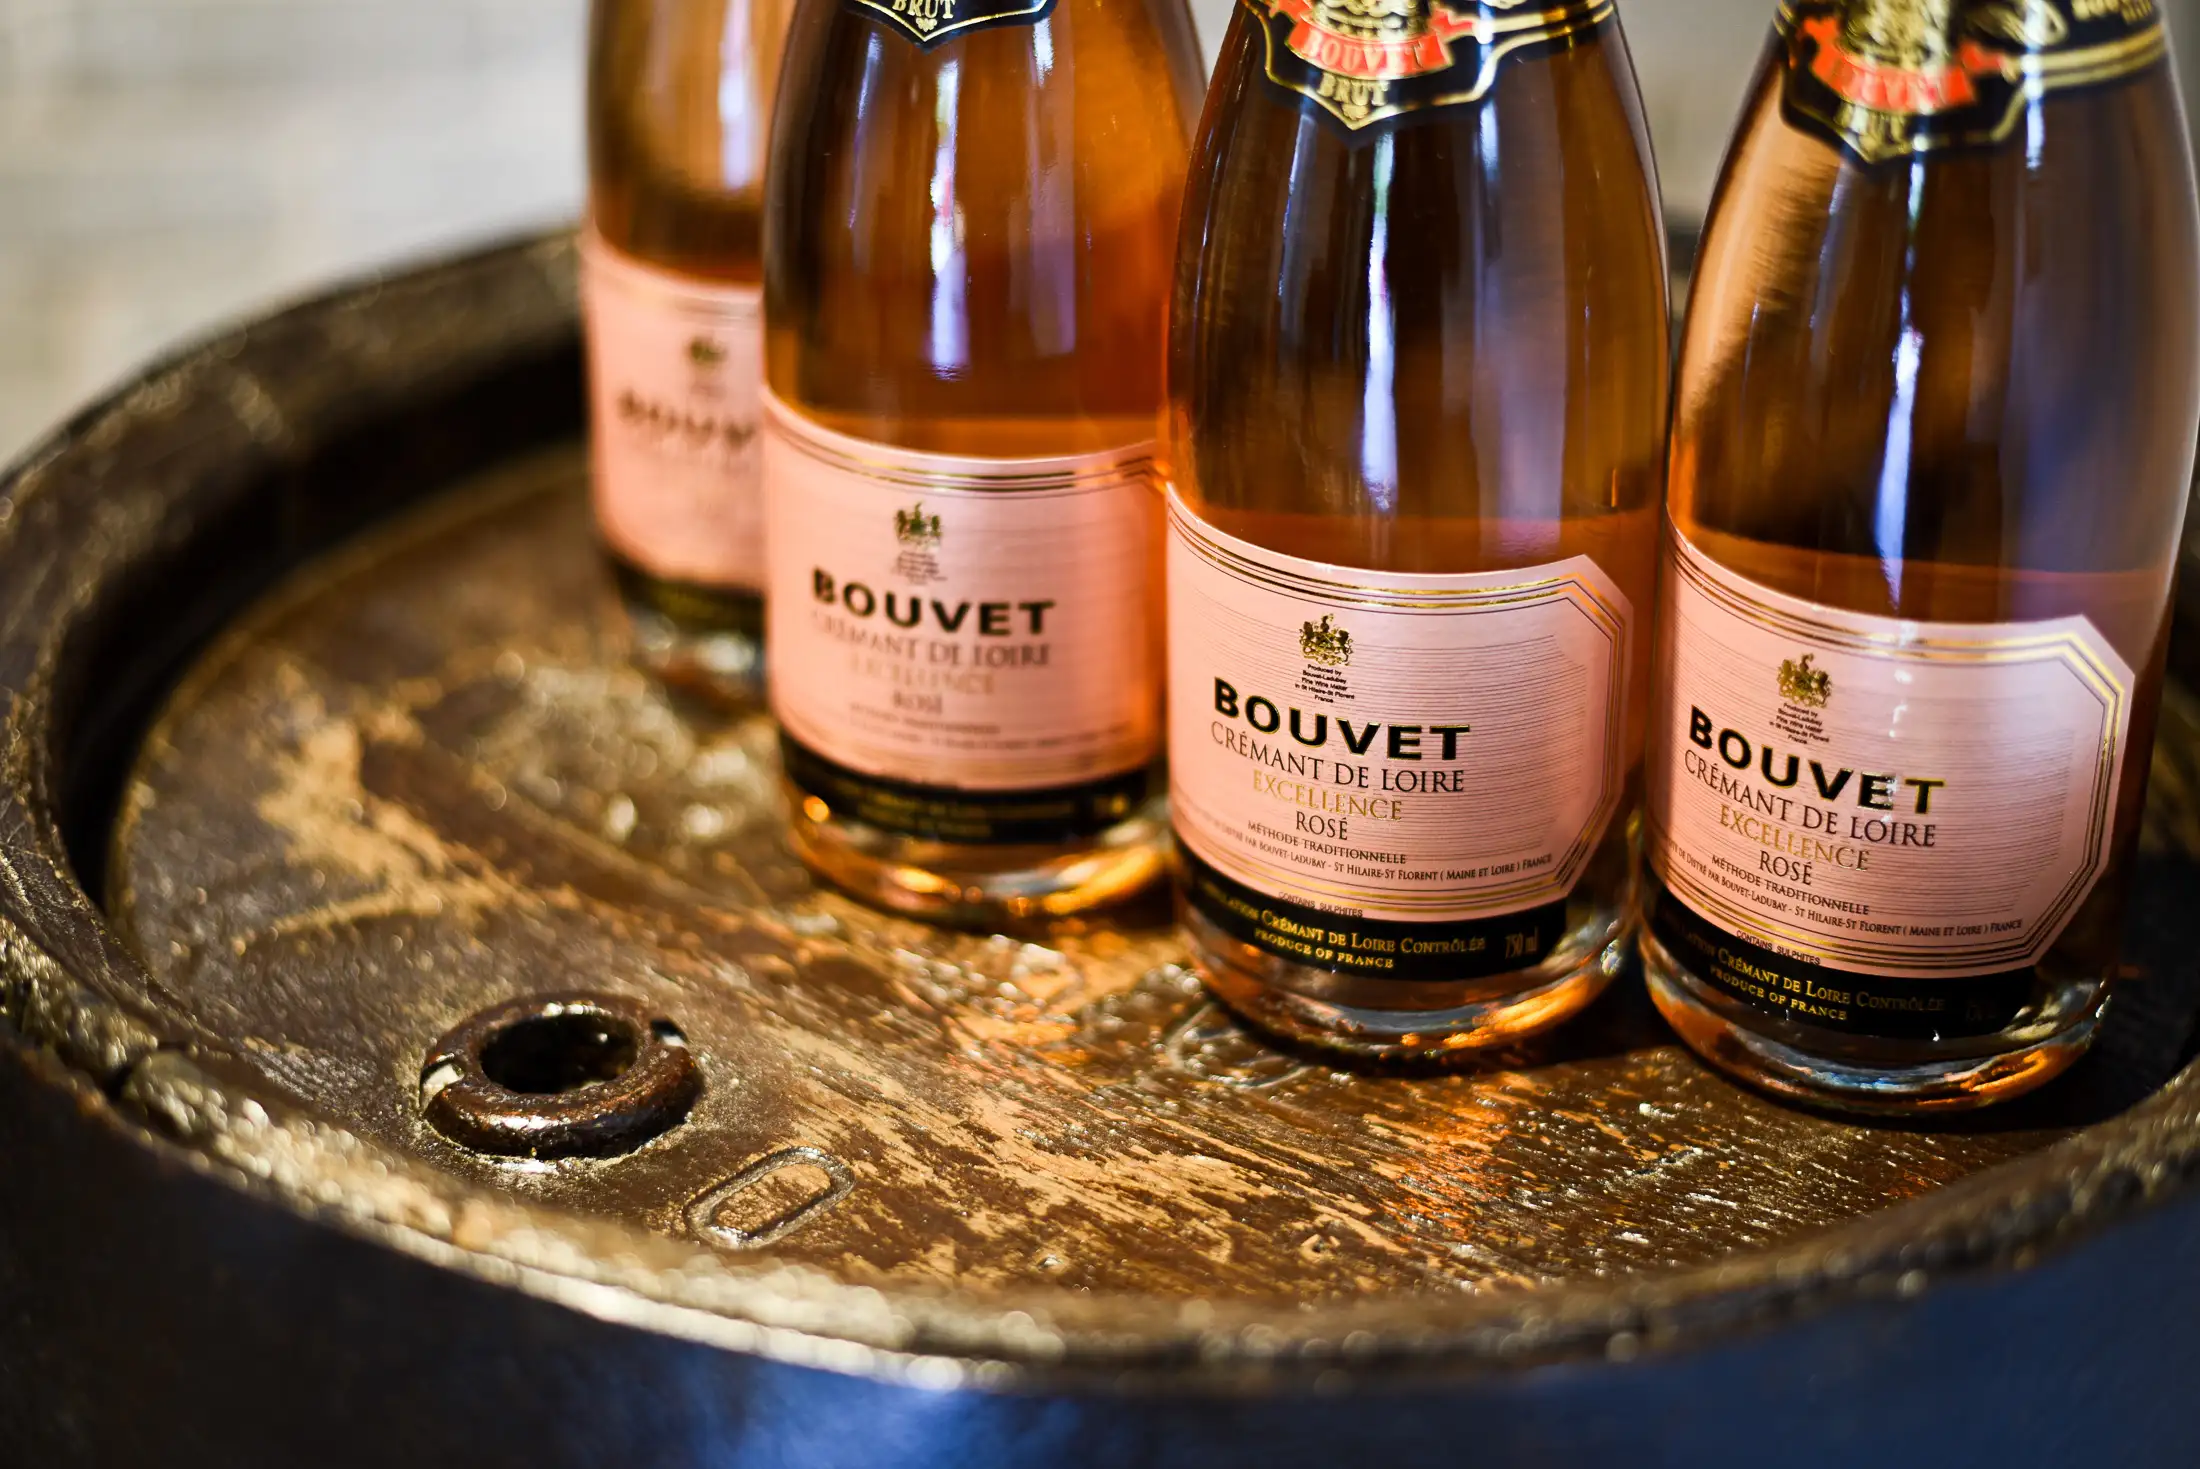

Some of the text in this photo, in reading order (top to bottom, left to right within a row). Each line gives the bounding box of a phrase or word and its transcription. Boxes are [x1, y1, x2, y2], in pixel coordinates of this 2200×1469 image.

[1317, 71, 1391, 106] BRUT
[812, 565, 1057, 636] BOUVET
[1213, 676, 1471, 761] BOUVET
[1210, 720, 1465, 793] CRÉMANT DE LOIRE
[1689, 703, 1946, 815] BOUVET
[1253, 769, 1403, 821] EXCELLENCE
[1685, 748, 1937, 848] CRÉMANT DE LOIRE
[1247, 819, 1407, 865] MÉTHODE TRADITIONNELLE
[1296, 810, 1349, 841] ROSÉ
[1720, 803, 1870, 872] EXCELLENCE
[1334, 861, 1345, 873] ST
[1398, 870, 1438, 881] FLORENT
[1446, 869, 1476, 880] MAINE
[1478, 868, 1489, 877] ET
[1491, 863, 1515, 876] LOIRE
[1711, 854, 1870, 916] MÉTHODE TRADITIONNELLE
[1759, 849, 1813, 886] ROSÉ
[1278, 891, 1316, 909] CONTAINS
[1319, 902, 1363, 917] SULPHITES
[1794, 905, 1806, 918] ST
[1860, 920, 1902, 936] FLORENT
[1909, 926, 1941, 937] MAINE
[1943, 926, 1955, 937] ET
[1956, 925, 1982, 936] LOIRE
[1990, 918, 2023, 933] FRANCE
[1254, 927, 1393, 969] PRODUCE OF FRANCE
[1328, 931, 1347, 946] DE
[1351, 932, 1396, 953] LOIRE
[1736, 929, 1773, 951] CONTAINS
[1776, 945, 1821, 966] SULPHITES
[1710, 964, 1847, 1021] PRODUCE OF FRANCE
[1718, 947, 1779, 986] CRÉMANT
[1783, 977, 1801, 993] DE
[1806, 979, 1850, 1005] LOIRE
